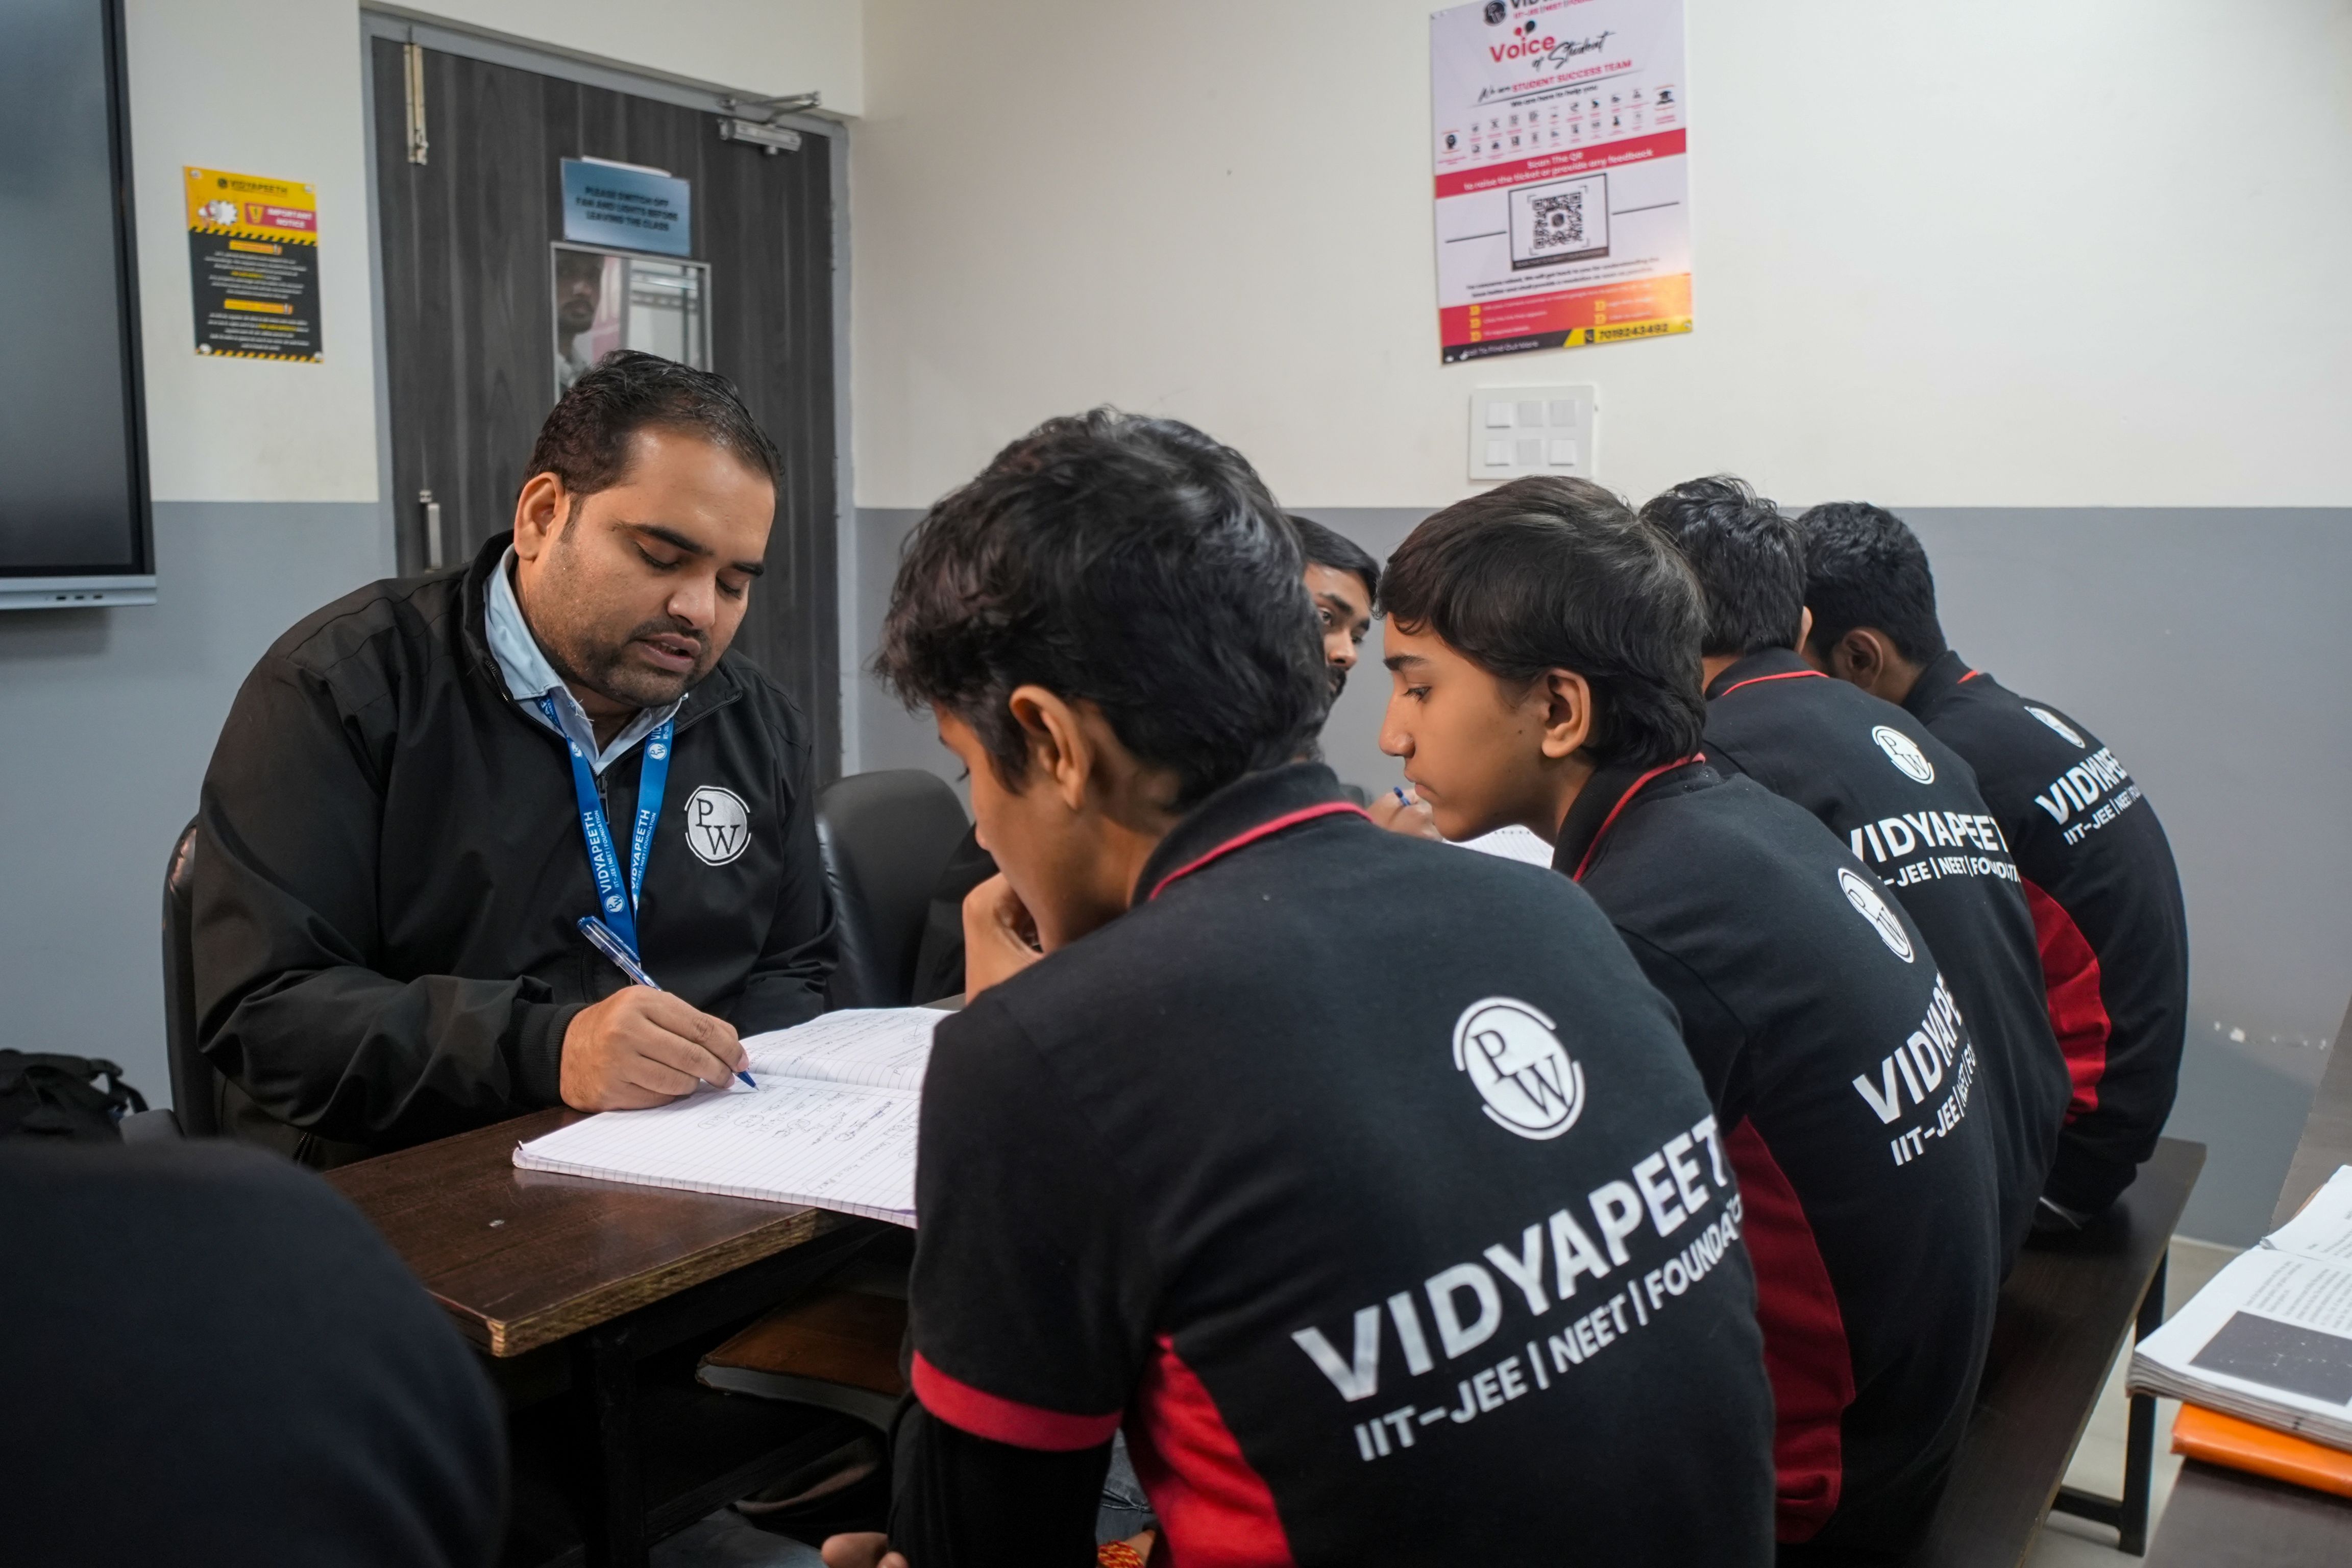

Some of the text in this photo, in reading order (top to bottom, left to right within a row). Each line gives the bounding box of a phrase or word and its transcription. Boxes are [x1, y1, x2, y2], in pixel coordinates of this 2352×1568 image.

[1489, 36, 1555, 62] Voice
[1511, 76, 1555, 92] STUDENT
[1557, 66, 1602, 83] SUCCESS
[1604, 60, 1632, 73] TEAM
[1475, 178, 1497, 188] raise
[1498, 175, 1512, 184] the
[1513, 170, 1540, 182] ticket
[1552, 161, 1587, 177] provide
[1588, 158, 1607, 169] any
[1608, 148, 1654, 164] feedback
[1527, 159, 1551, 170] Scan
[1569, 152, 1584, 161] QR
[267, 208, 312, 219] IMPORTANT
[276, 217, 305, 228] NOTICE
[594, 810, 608, 847] FOUNDATION
[643, 812, 656, 850] FOUNDATION
[2064, 804, 2116, 845] IIT-JEE
[583, 811, 612, 894] VIDYAPEETH
[605, 851, 614, 866] NEET
[1938, 855, 1967, 875] NEET
[610, 868, 620, 888] IIT-JEE
[1891, 1095, 1960, 1166] IIT-JEE
[1292, 1115, 1728, 1402] VIDYAPEET
[1354, 1355, 1529, 1462] IIT-JEE
[1549, 1294, 1630, 1374] NEET
